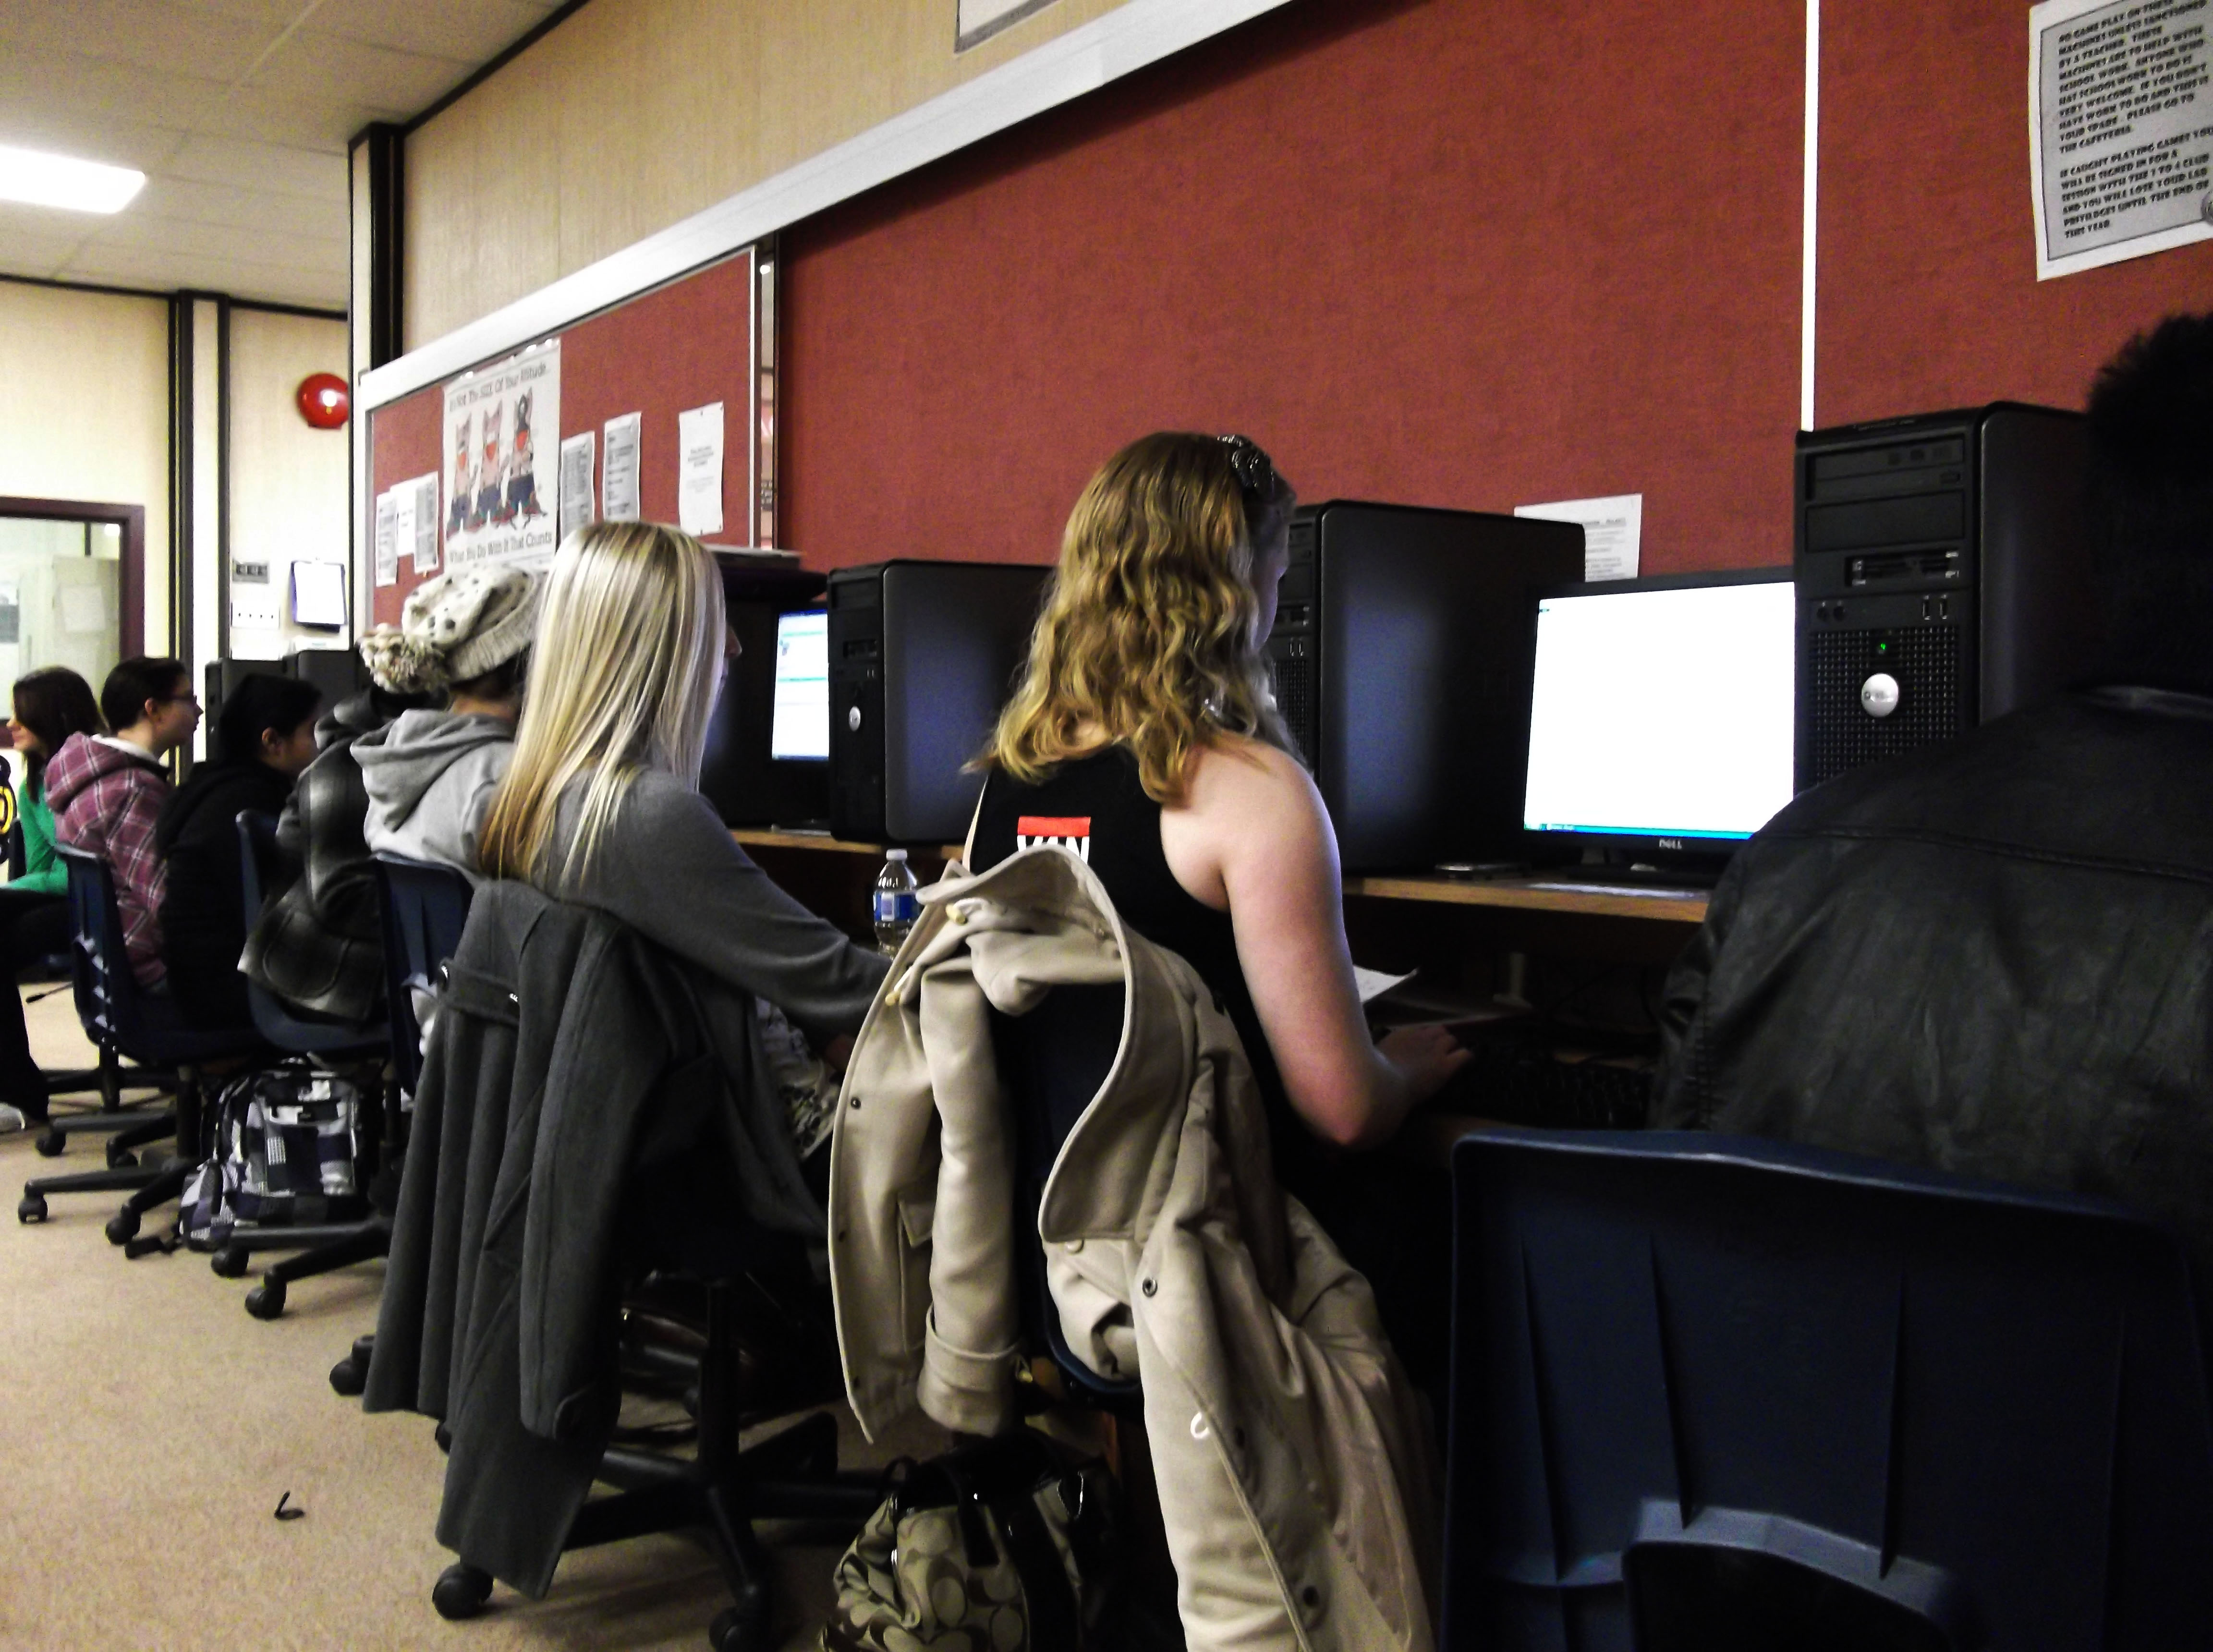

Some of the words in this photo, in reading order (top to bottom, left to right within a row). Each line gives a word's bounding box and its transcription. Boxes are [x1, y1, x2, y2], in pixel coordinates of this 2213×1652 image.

[477, 544, 486, 558] Do
[487, 541, 502, 555] With
[503, 538, 509, 553] It
[510, 537, 524, 550] That
[526, 532, 552, 547] Counts
